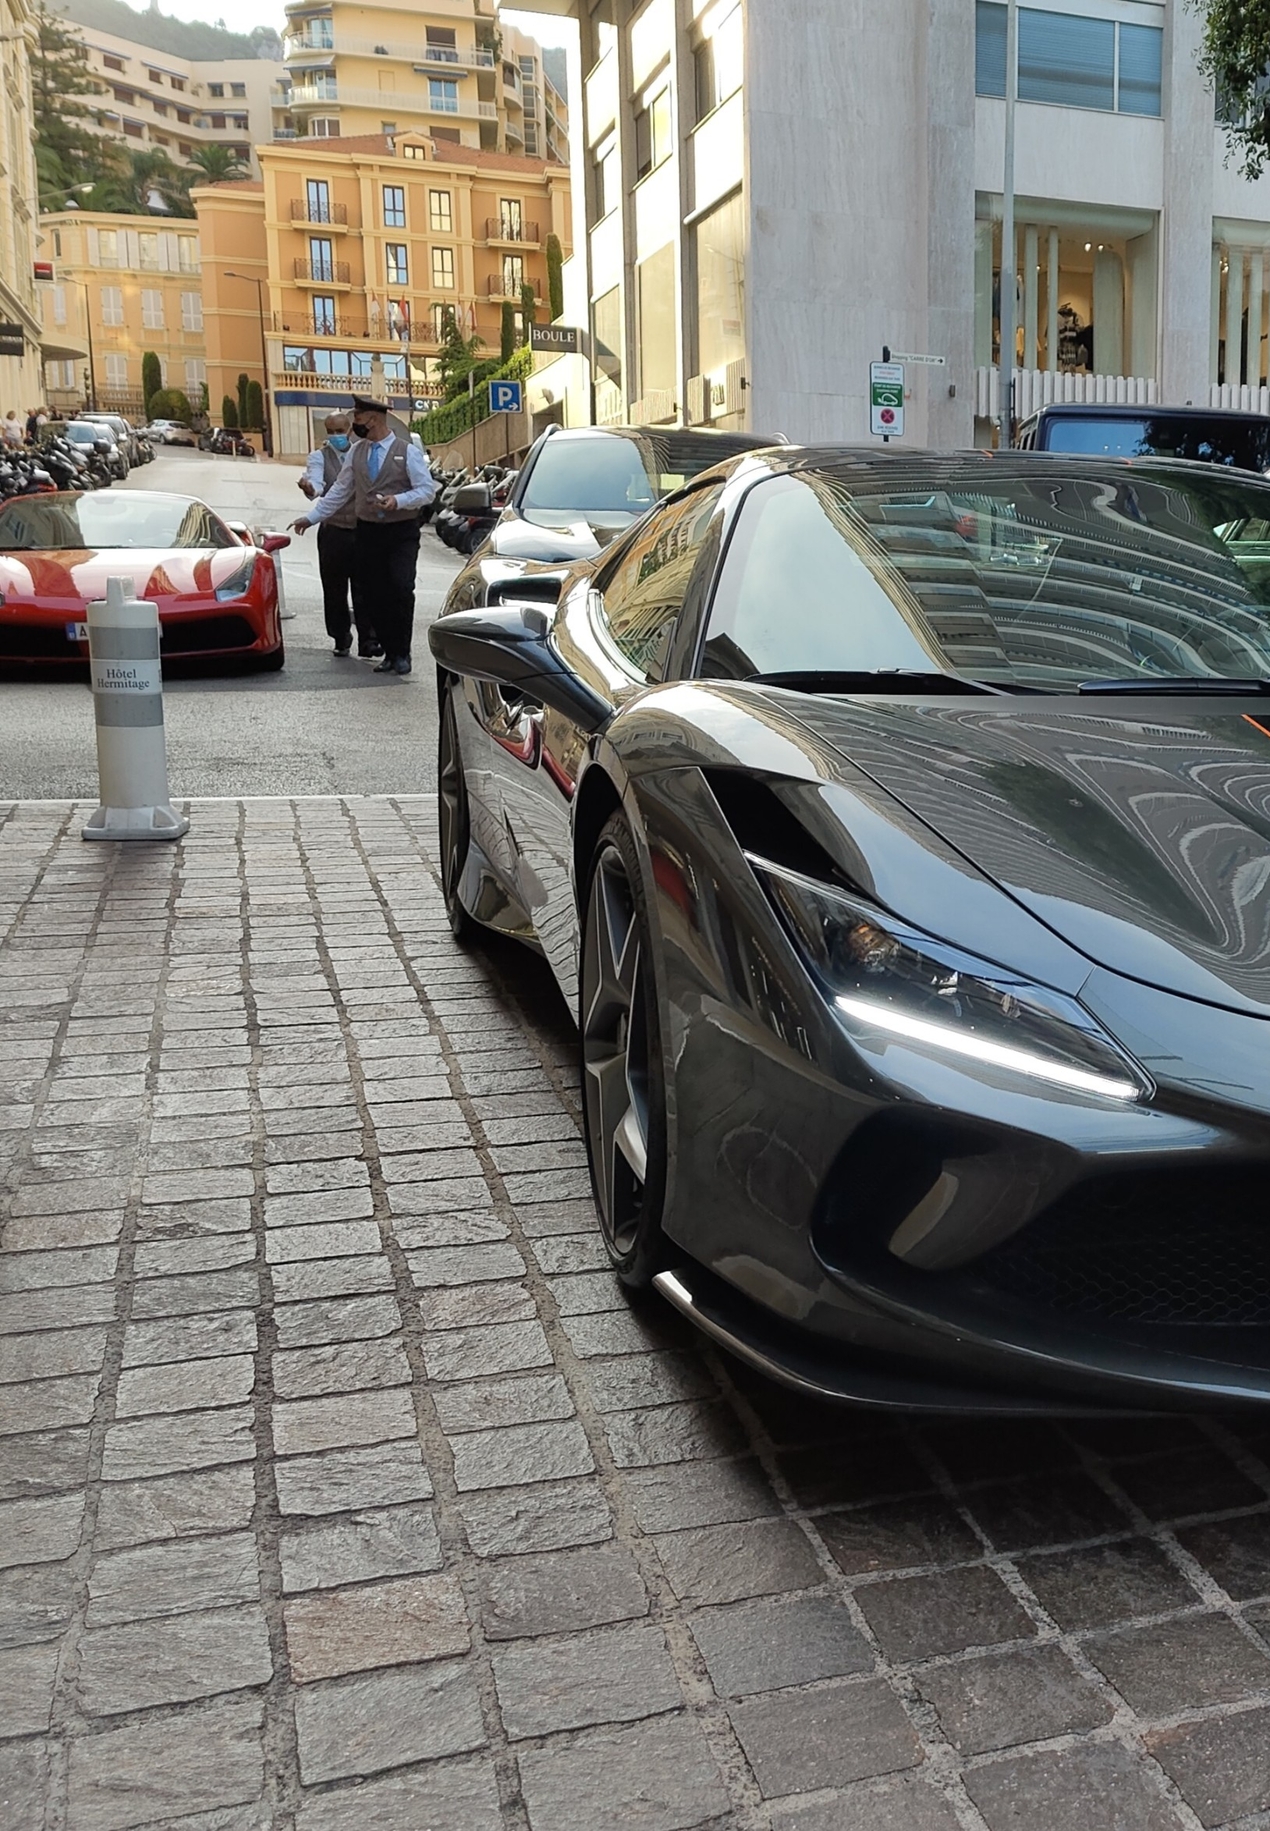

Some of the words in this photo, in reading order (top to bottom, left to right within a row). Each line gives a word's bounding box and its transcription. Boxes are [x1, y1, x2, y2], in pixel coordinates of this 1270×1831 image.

[533, 329, 575, 343] BOULE
[498, 386, 513, 407] P
[106, 668, 137, 679] Hôtel
[97, 678, 150, 690] Hermitage
